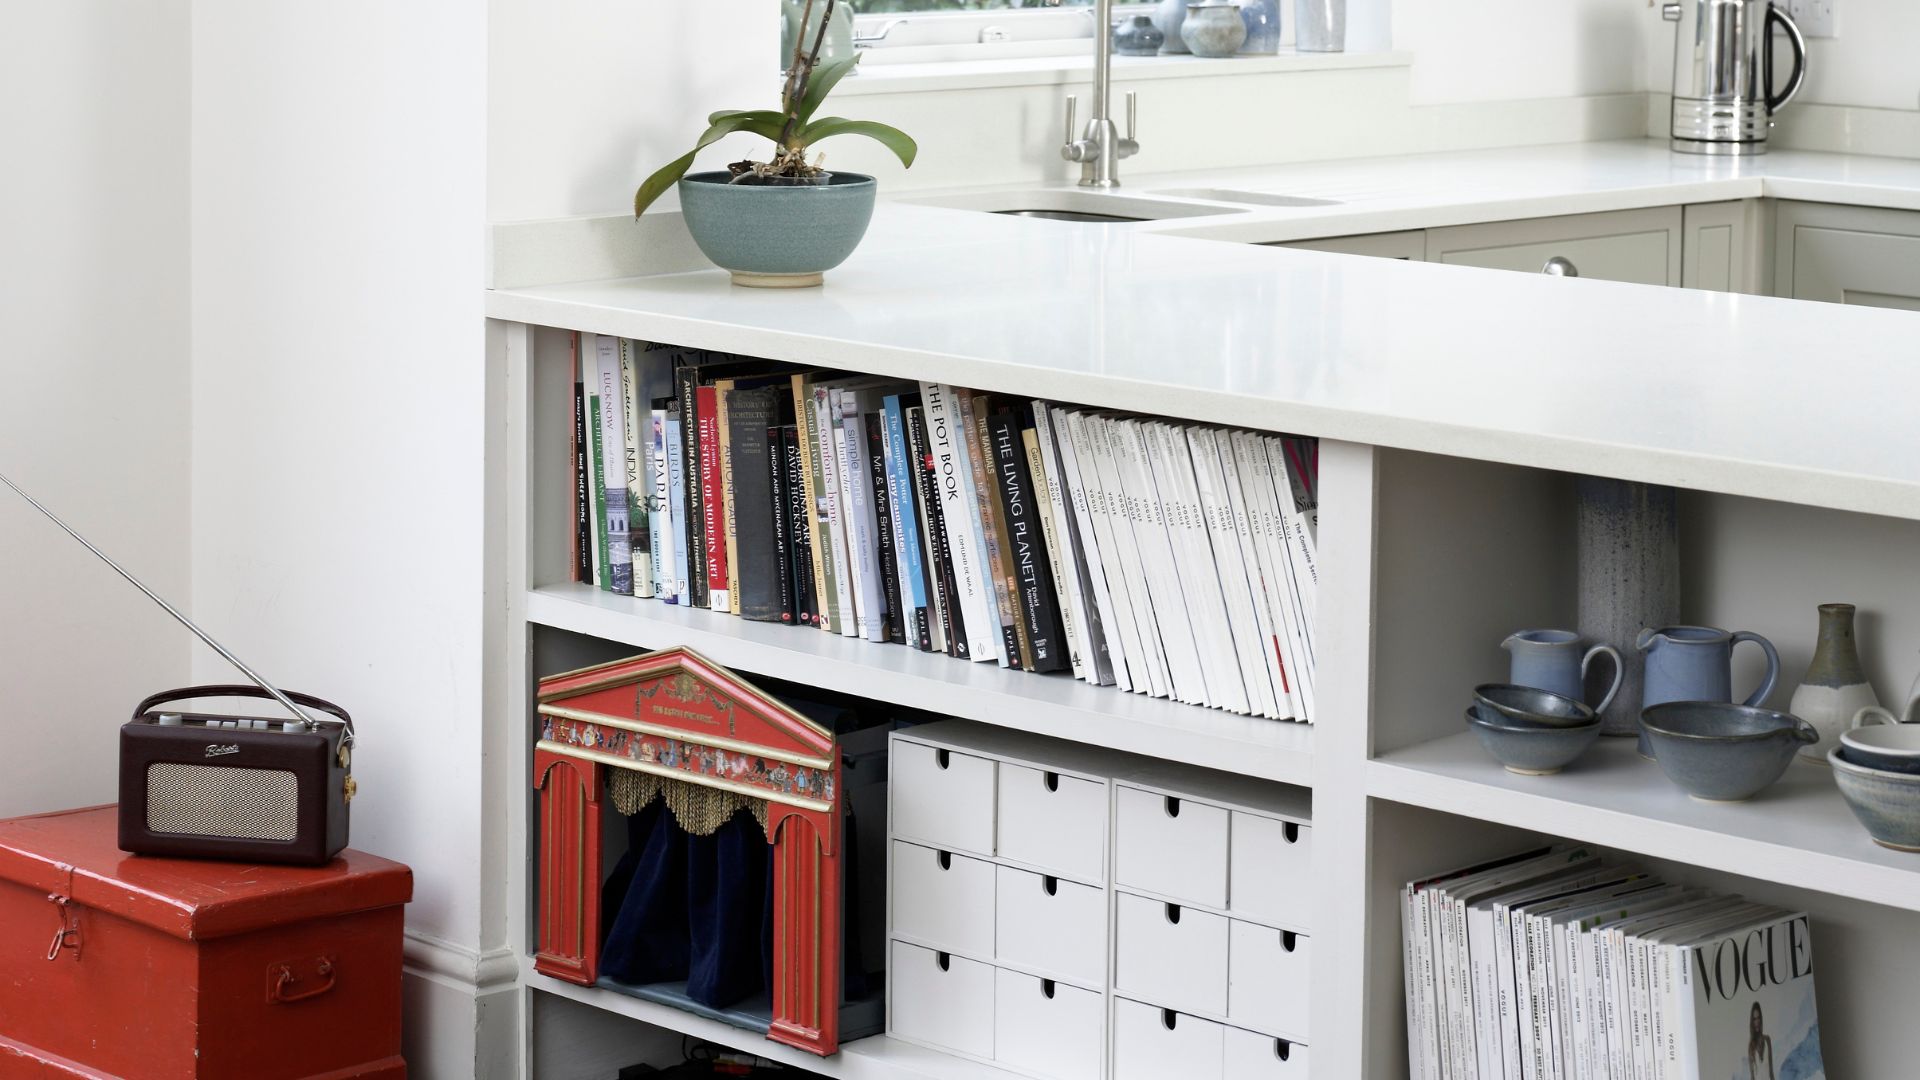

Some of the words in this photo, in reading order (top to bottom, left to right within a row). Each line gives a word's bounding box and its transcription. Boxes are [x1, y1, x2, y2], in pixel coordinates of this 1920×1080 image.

[603, 372, 614, 430] LUCKNOW
[928, 384, 943, 413] THE
[684, 380, 694, 446] ARCHITECTURE
[806, 399, 819, 437] Casual
[890, 414, 898, 431] The
[978, 417, 987, 434] THE
[594, 408, 603, 460] ARCHITECT
[700, 417, 709, 442] THE
[934, 418, 949, 448] POT
[996, 424, 1013, 459] THE
[626, 447, 637, 484] INDIA
[645, 442, 656, 471] Paris
[670, 443, 680, 488] BIRDS
[689, 447, 695, 457] IN
[701, 444, 711, 482] STORY
[770, 446, 779, 476] MINOAN
[787, 445, 797, 483] DAVID
[797, 399, 807, 437] BRISTOL'S
[805, 470, 815, 513] BUILDINGS
[810, 442, 821, 478] Living
[874, 456, 883, 473] Mr
[892, 434, 905, 476] Complete
[981, 436, 995, 475] MAMMALS
[689, 459, 698, 508] AUSTRALIA
[724, 445, 734, 497] ANTONI
[820, 428, 834, 484] comforts
[828, 492, 839, 527] home
[876, 477, 884, 485] &
[941, 454, 958, 501] BOOK
[971, 452, 982, 478] guide
[977, 482, 984, 492] to
[655, 458, 667, 514] PARIS
[705, 485, 712, 500] OF
[796, 448, 810, 523] ABORIGINAL
[804, 524, 812, 547] ART
[889, 474, 899, 496] tiny
[900, 479, 909, 505] Potter
[1003, 463, 1023, 517] LIVING
[1054, 482, 1062, 507] VOGUE
[877, 490, 887, 513] Mrs
[920, 464, 930, 499] CLIFTON
[928, 517, 939, 563] HOTWELLS
[1077, 489, 1086, 513] VOGUE
[1089, 489, 1098, 514] VOGUE
[1097, 491, 1106, 515] VOGUE
[1108, 492, 1117, 516] VOGUE
[1118, 493, 1127, 518] VOGUE
[1127, 496, 1136, 521] VOGUE
[1134, 498, 1143, 523] VOGUE
[1143, 499, 1152, 523] VOGUE
[1153, 502, 1162, 526] VOGUE
[1166, 502, 1175, 527] VOGUE
[1175, 502, 1184, 526] VOGUE
[706, 503, 718, 553] MODERN
[774, 496, 783, 538] MYCENAEAN
[791, 486, 803, 545] HOCKNEY
[892, 498, 906, 553] campsites
[932, 474, 942, 511] BARBARA
[939, 514, 949, 559] HEPWORTH
[1182, 504, 1192, 530] VOGUE
[1192, 504, 1202, 529] VOGUE
[1209, 505, 1217, 530] VOGUE
[1218, 507, 1227, 532] VOGUE
[1225, 505, 1234, 530] VOGUE
[1238, 512, 1246, 537] VOGUE
[1252, 510, 1260, 535] VOGUE
[1264, 512, 1273, 537] VOGUE
[1275, 515, 1283, 540] VOGUE
[1283, 515, 1292, 540] VOGUE
[822, 534, 830, 553] Judith
[880, 516, 889, 548] Smith
[1046, 529, 1054, 550] Pearson
[1294, 522, 1302, 534] The
[1299, 535, 1312, 565] Complete
[958, 535, 968, 566] EDMUND
[1014, 522, 1036, 586] PLANET
[710, 557, 718, 580] ART
[824, 554, 832, 576] Wilson
[963, 567, 969, 576] DE
[886, 577, 896, 618] Collection
[938, 581, 948, 608] HELEN
[965, 577, 974, 597] WAAL
[1031, 586, 1040, 607] David
[942, 609, 950, 629] REID
[1011, 594, 1020, 619] NATURE
[1016, 622, 1025, 650] LIBRARY
[1026, 588, 1039, 634] Attenborough
[1006, 629, 1016, 657] APPLE
[205, 744, 239, 757] Roberts
[1693, 916, 1811, 1004] VOGUE
[1668, 1033, 1676, 1062] VOGUE
